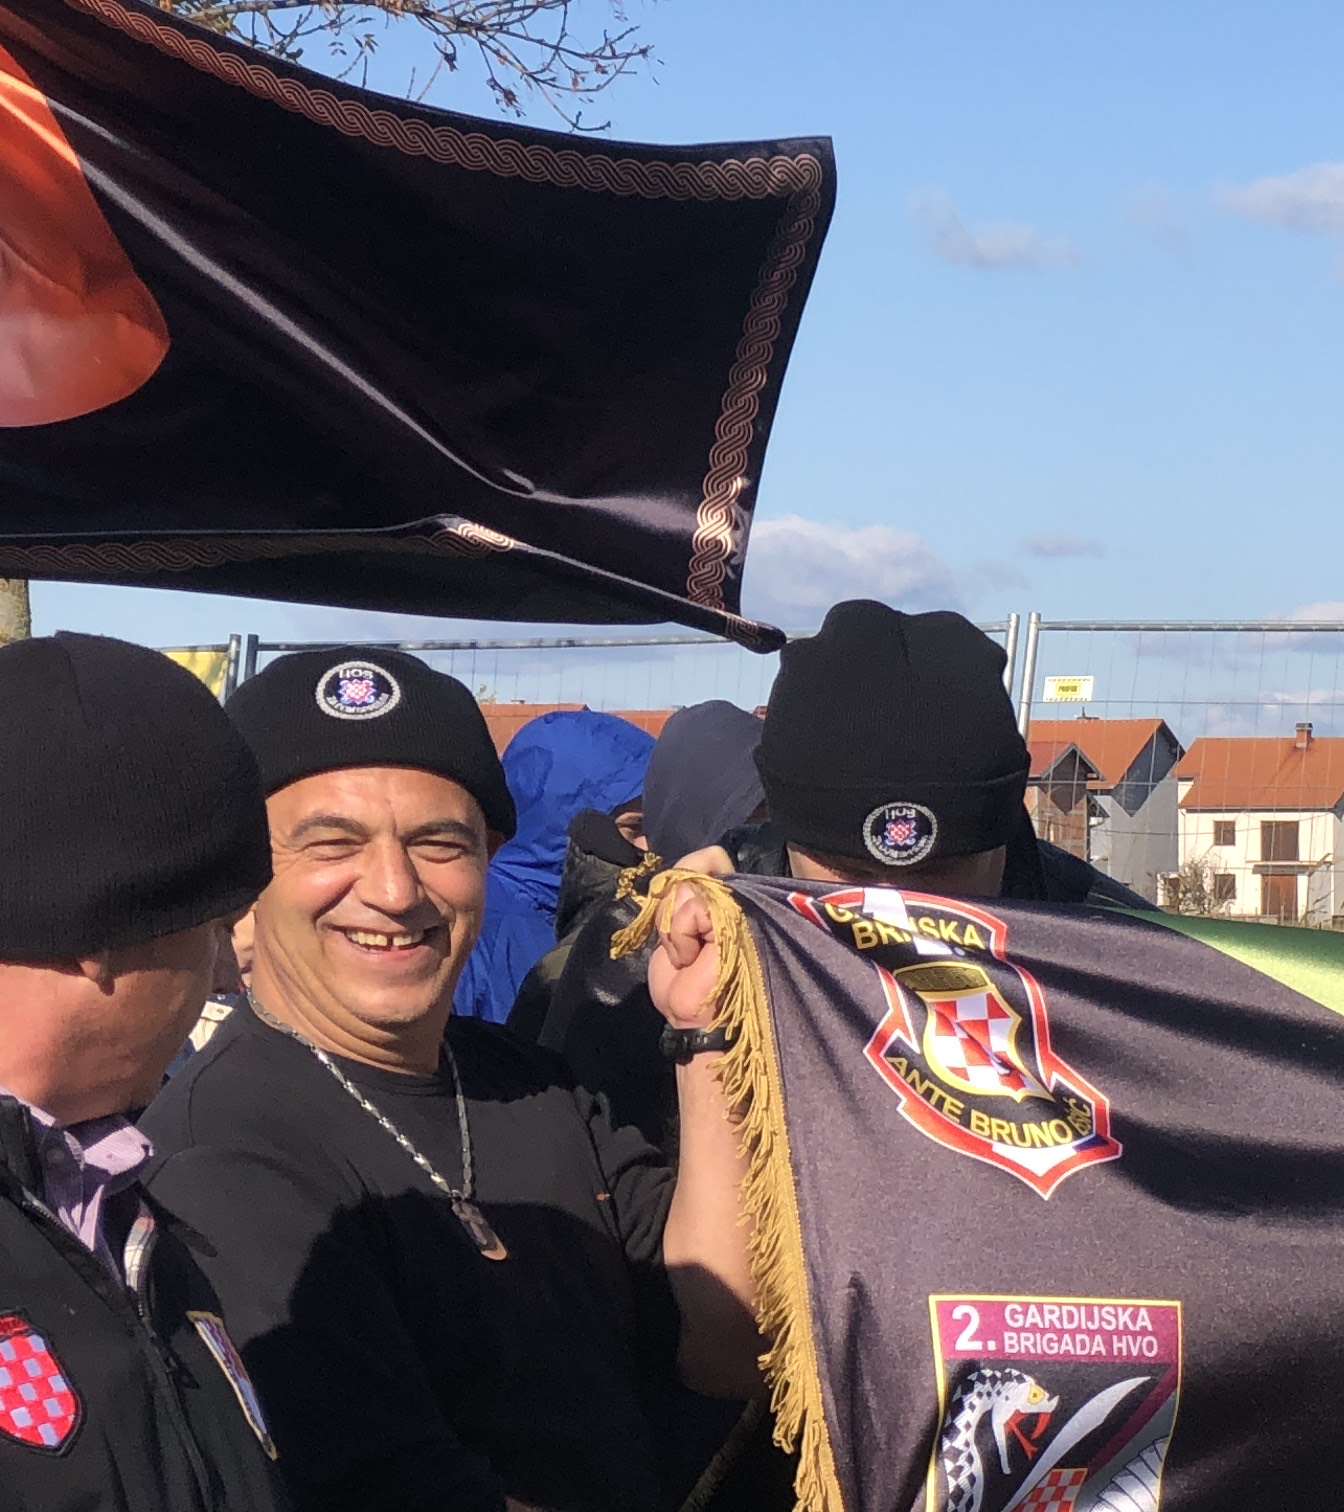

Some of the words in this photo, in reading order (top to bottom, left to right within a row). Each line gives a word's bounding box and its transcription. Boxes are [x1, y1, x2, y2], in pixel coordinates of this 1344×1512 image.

[885, 1056, 965, 1123] ANTE
[969, 1108, 1073, 1148] BRUNO
[951, 1305, 996, 1352] 2.
[1004, 1304, 1153, 1332] GARDIJSKA
[1004, 1331, 1107, 1356] BRIGADA
[1112, 1335, 1159, 1358] HVO
